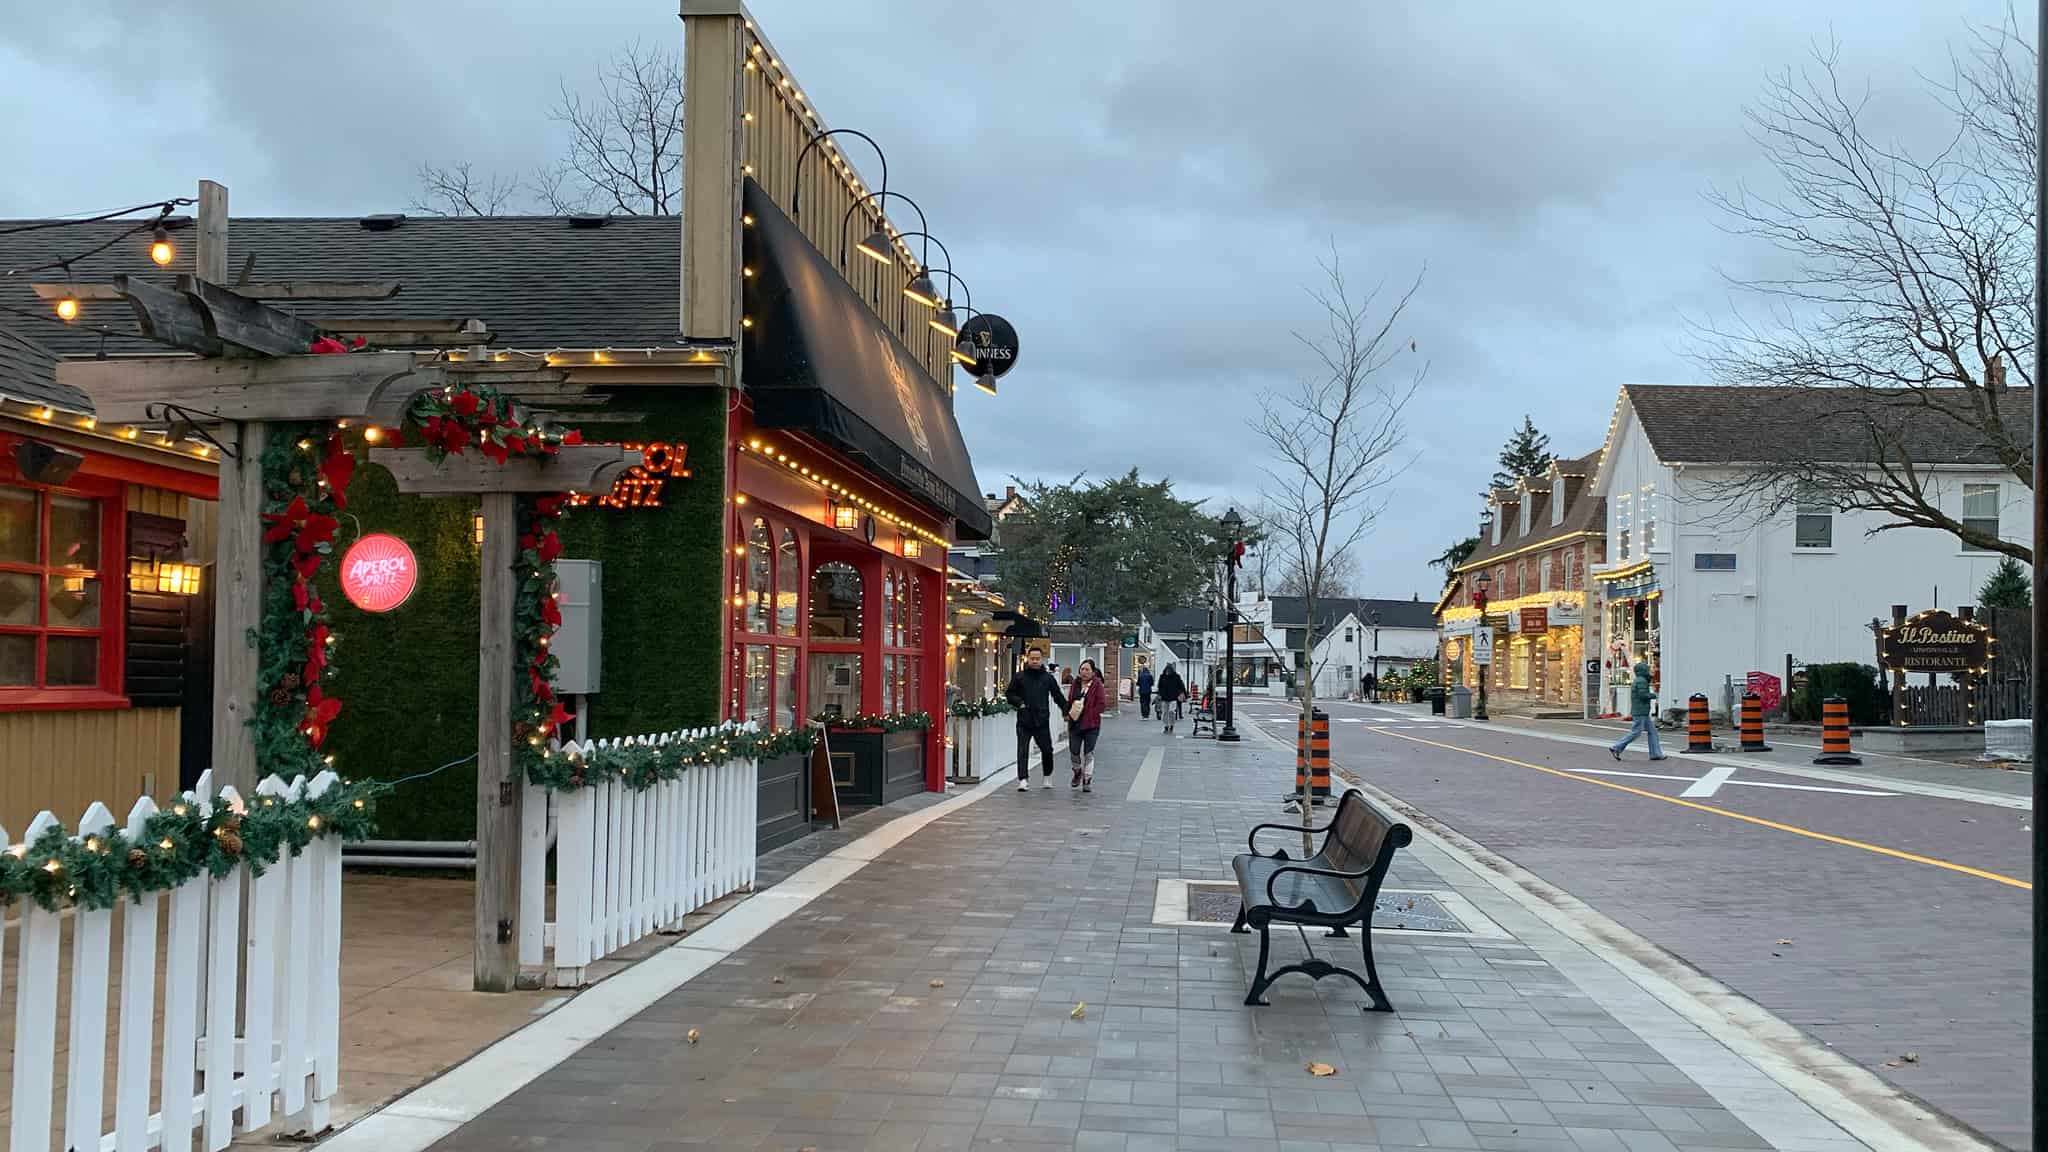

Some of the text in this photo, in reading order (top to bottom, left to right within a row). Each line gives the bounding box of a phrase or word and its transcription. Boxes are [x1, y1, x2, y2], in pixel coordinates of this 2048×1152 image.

[976, 347, 1012, 360] INNESS
[350, 557, 407, 579] APEROL
[359, 573, 397, 587] SPRITZ
[1897, 627, 1976, 644] Il Postino
[1904, 657, 1968, 667] RISTORANTE
